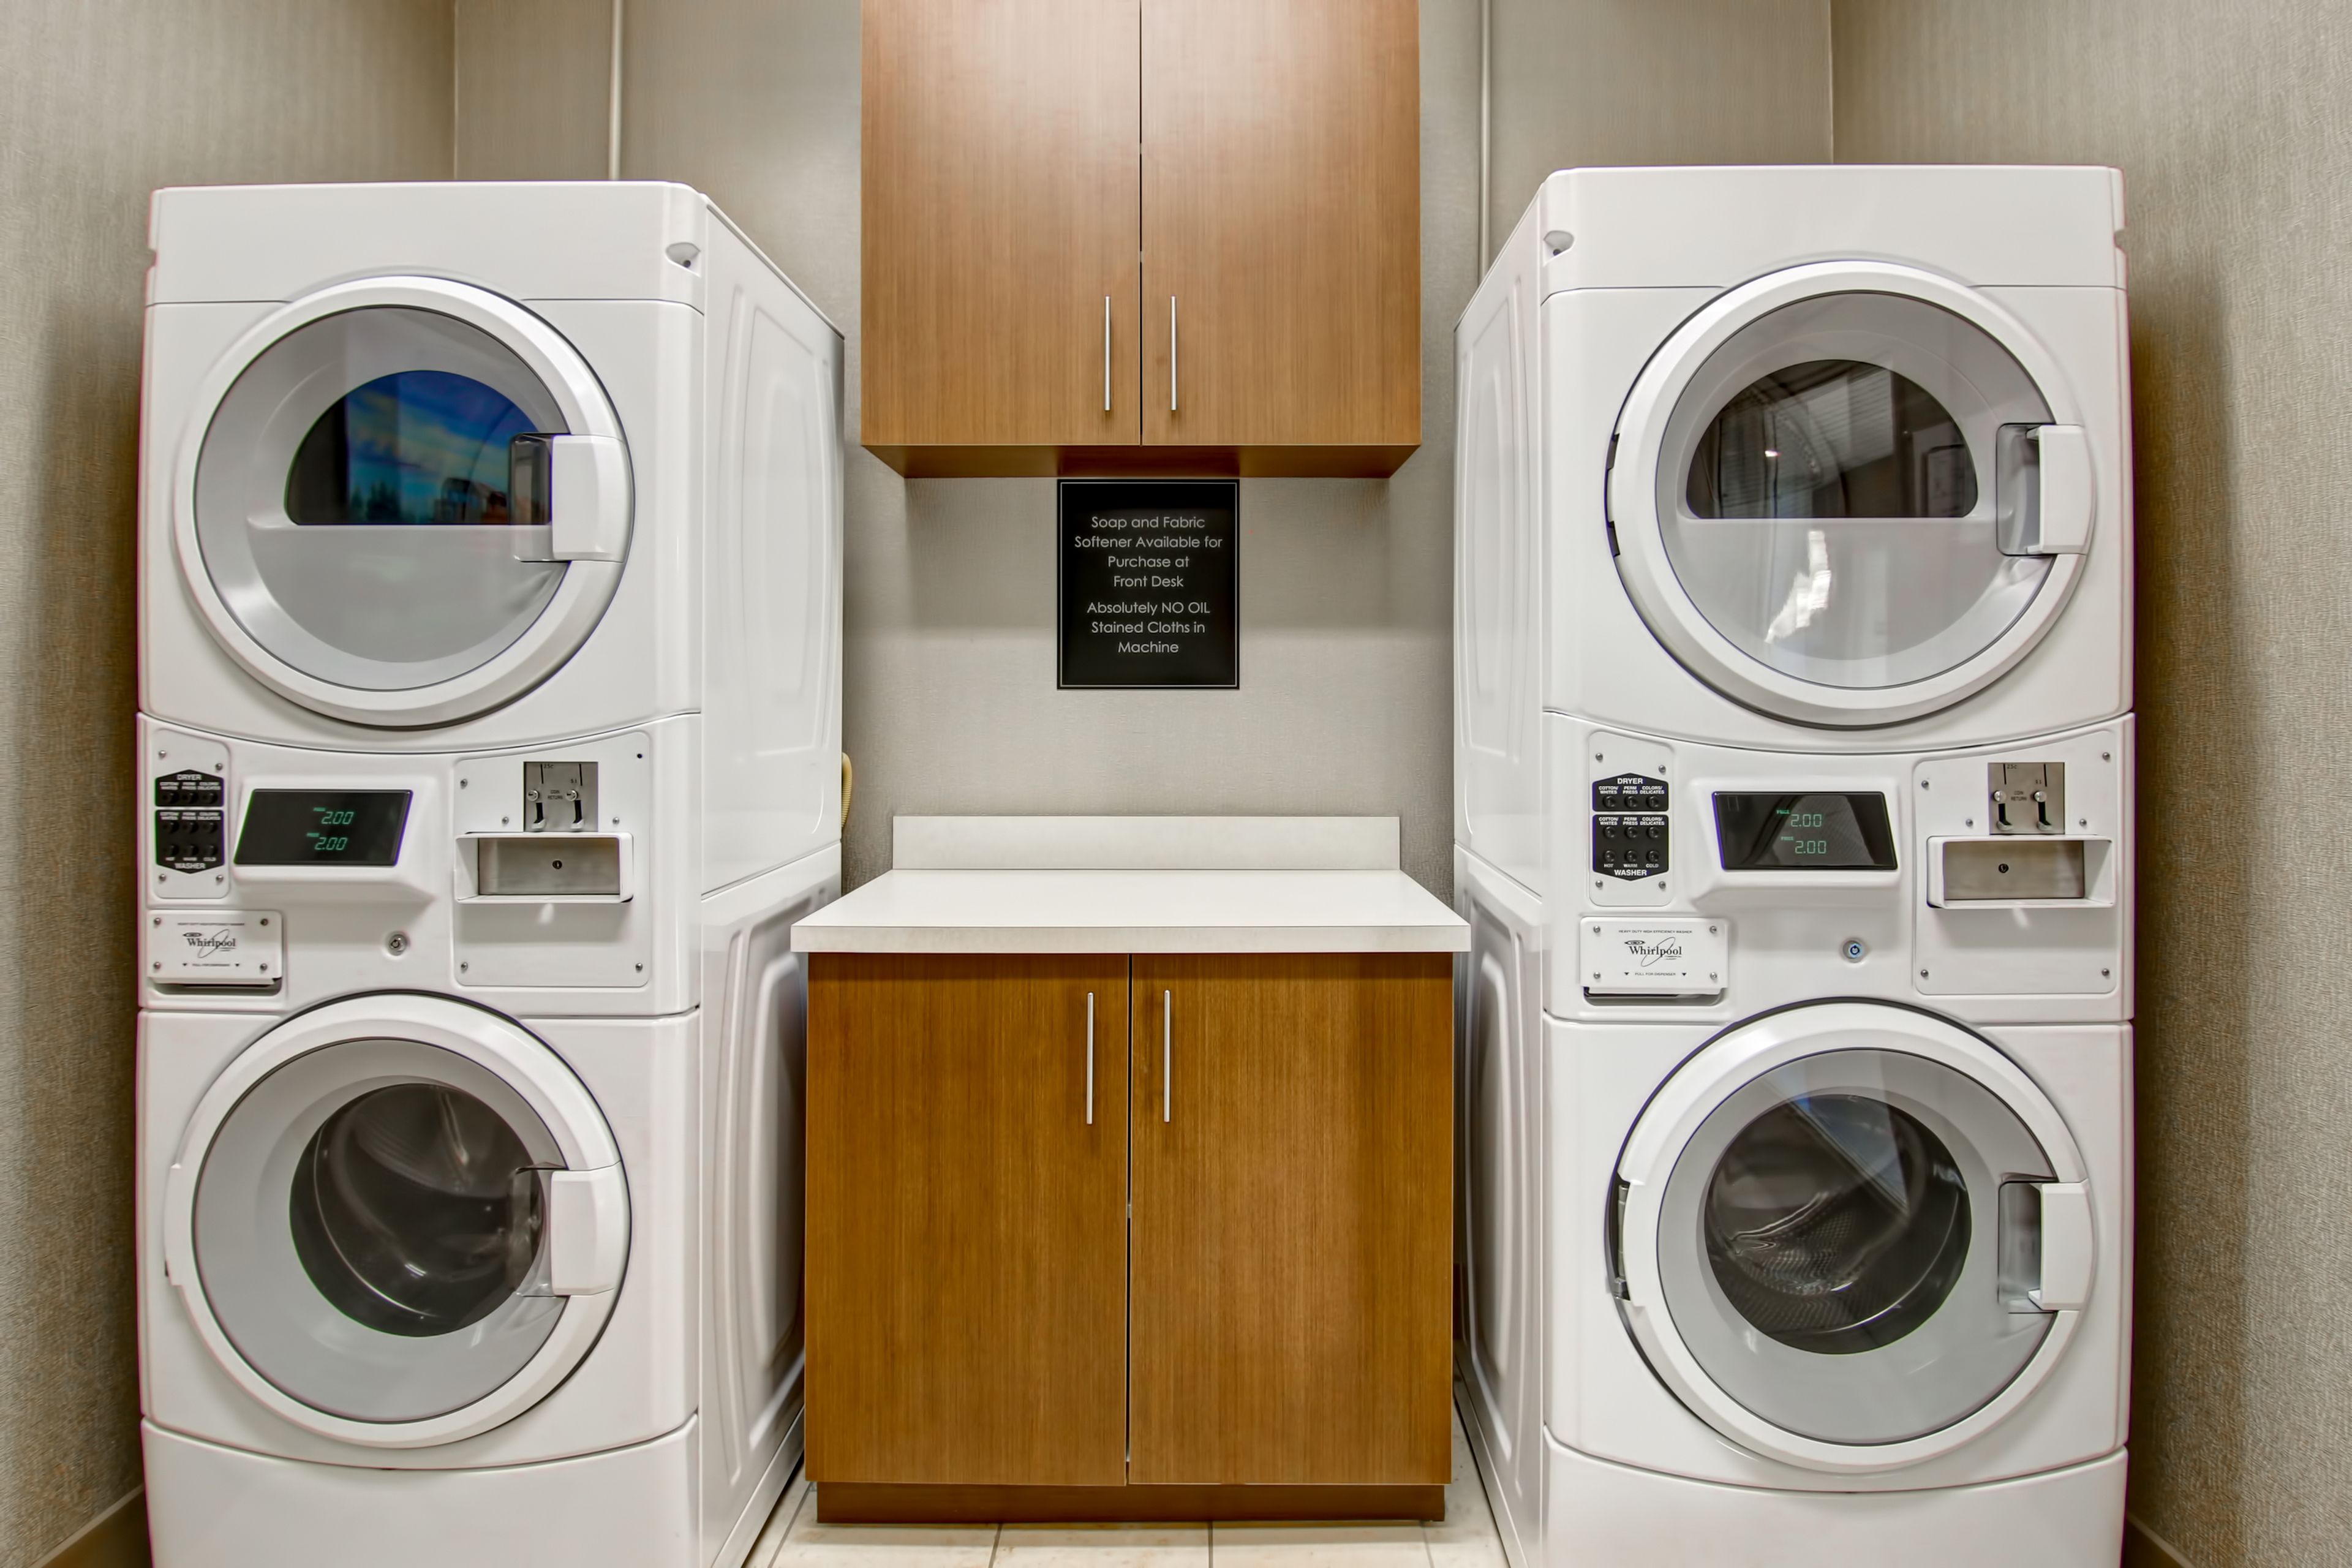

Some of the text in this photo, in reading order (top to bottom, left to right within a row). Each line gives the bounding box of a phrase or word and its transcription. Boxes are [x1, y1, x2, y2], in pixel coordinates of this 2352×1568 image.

[1091, 516, 1205, 530] Soap and Fabric
[1074, 535, 1223, 548] Softener Available for
[1108, 556, 1189, 568] Purchase at
[1114, 575, 1184, 587] Front Desk
[1087, 601, 1210, 616] Absolutely NO OIL
[1091, 621, 1205, 633] Stained Cloths in
[1118, 641, 1179, 653] Machine
[321, 812, 354, 824] 2.00
[1790, 814, 1822, 827] 2.00
[314, 837, 348, 850] 2.00
[1795, 840, 1826, 854] 2.00
[186, 938, 236, 949] Whirlpool
[1629, 946, 1682, 957] Whirlpool
